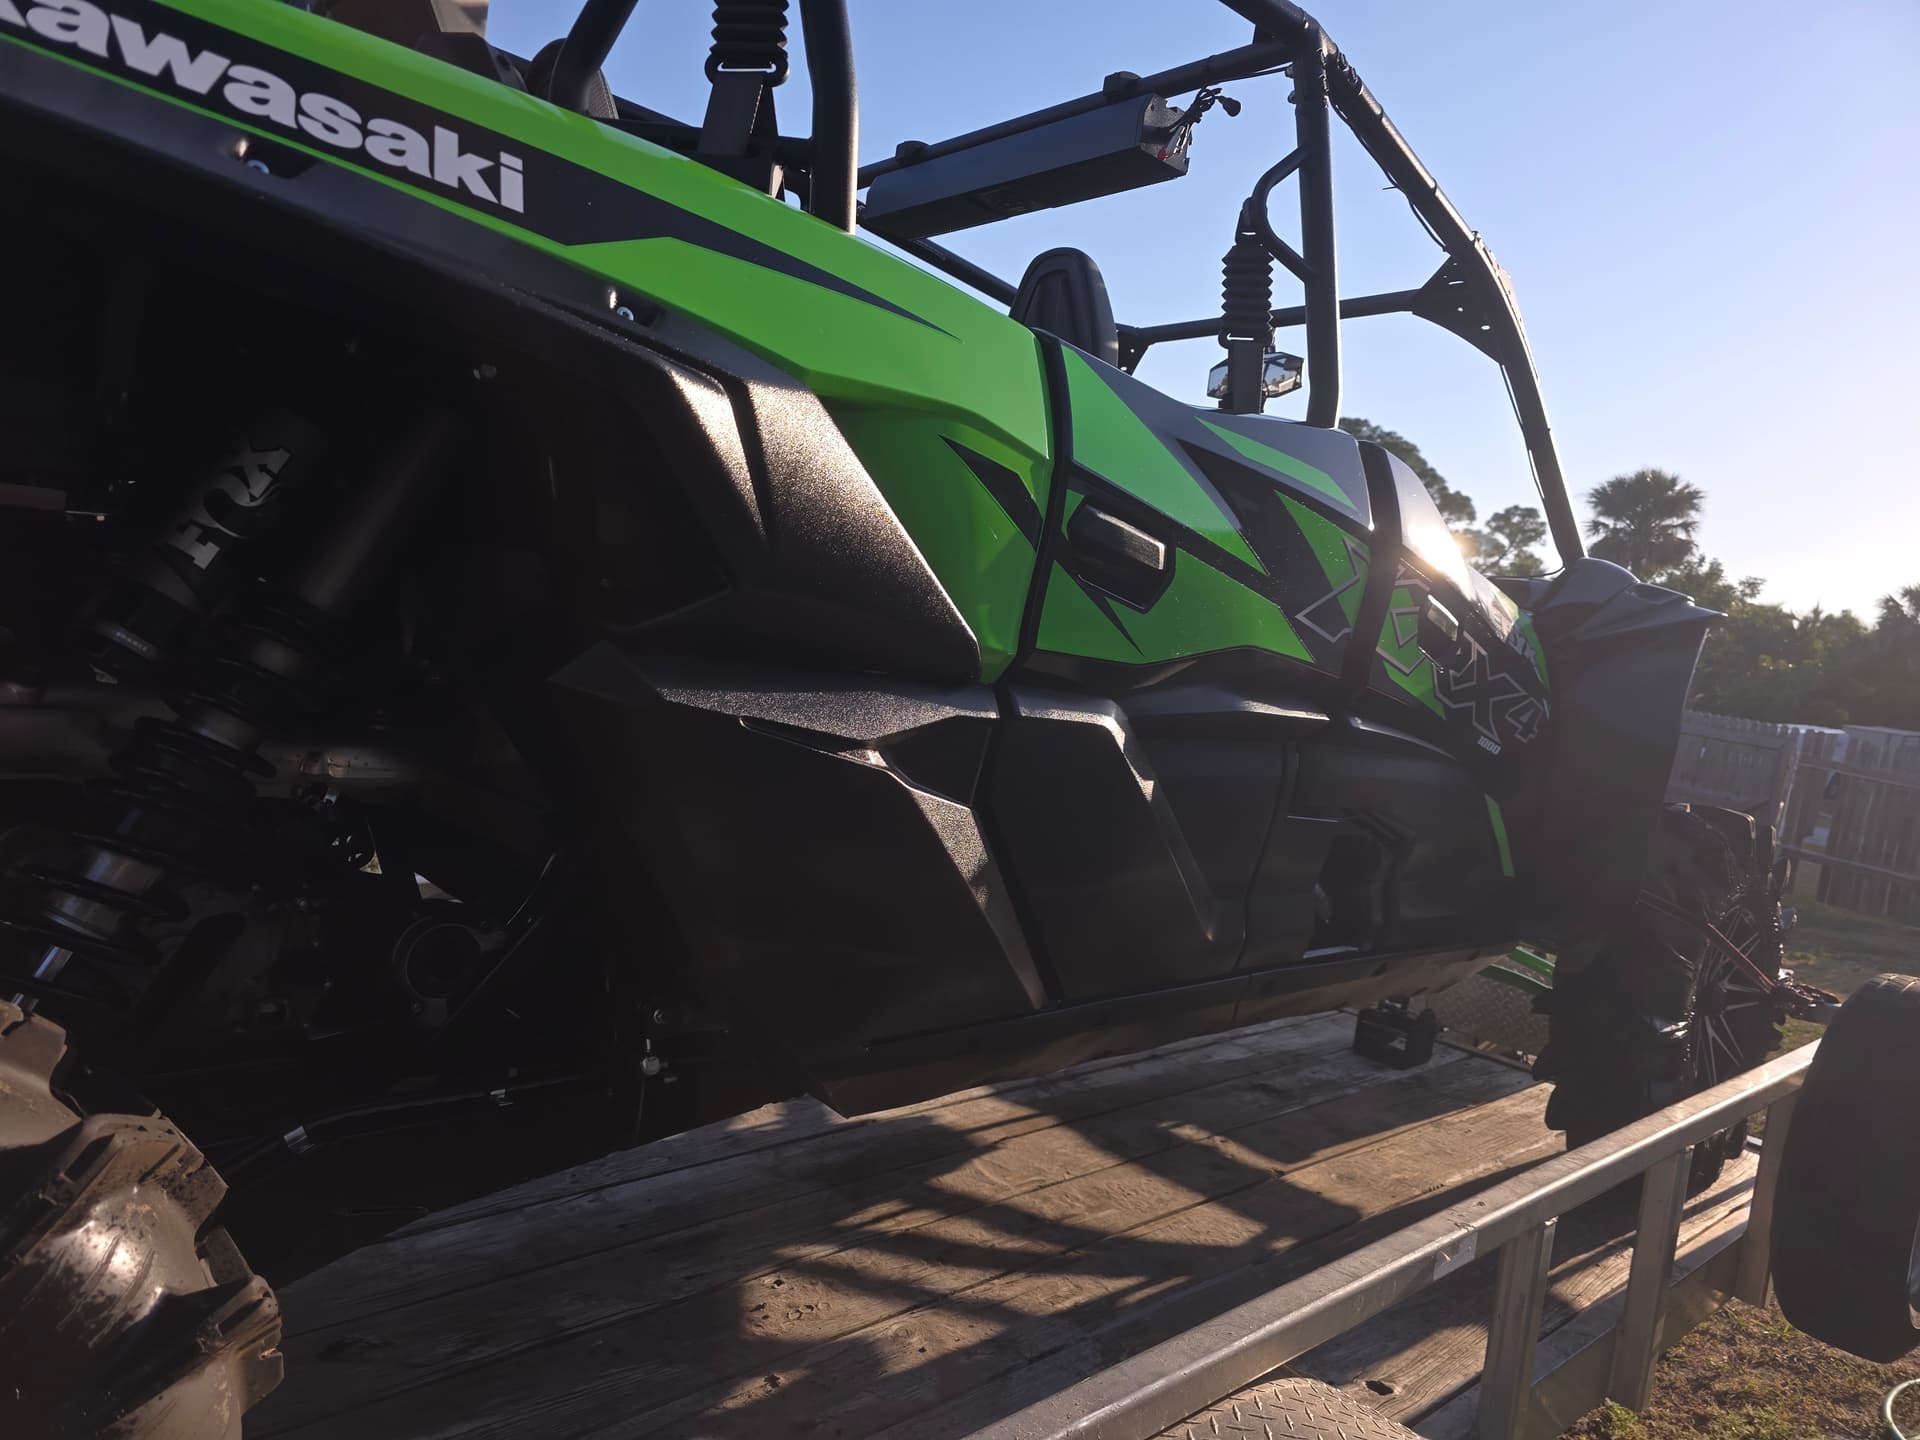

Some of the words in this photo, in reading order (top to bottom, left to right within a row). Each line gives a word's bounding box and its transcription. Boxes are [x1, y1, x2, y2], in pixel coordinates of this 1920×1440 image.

[0, 0, 525, 214] awasaki
[168, 441, 291, 570] FOX
[1478, 735, 1501, 755] 1000
